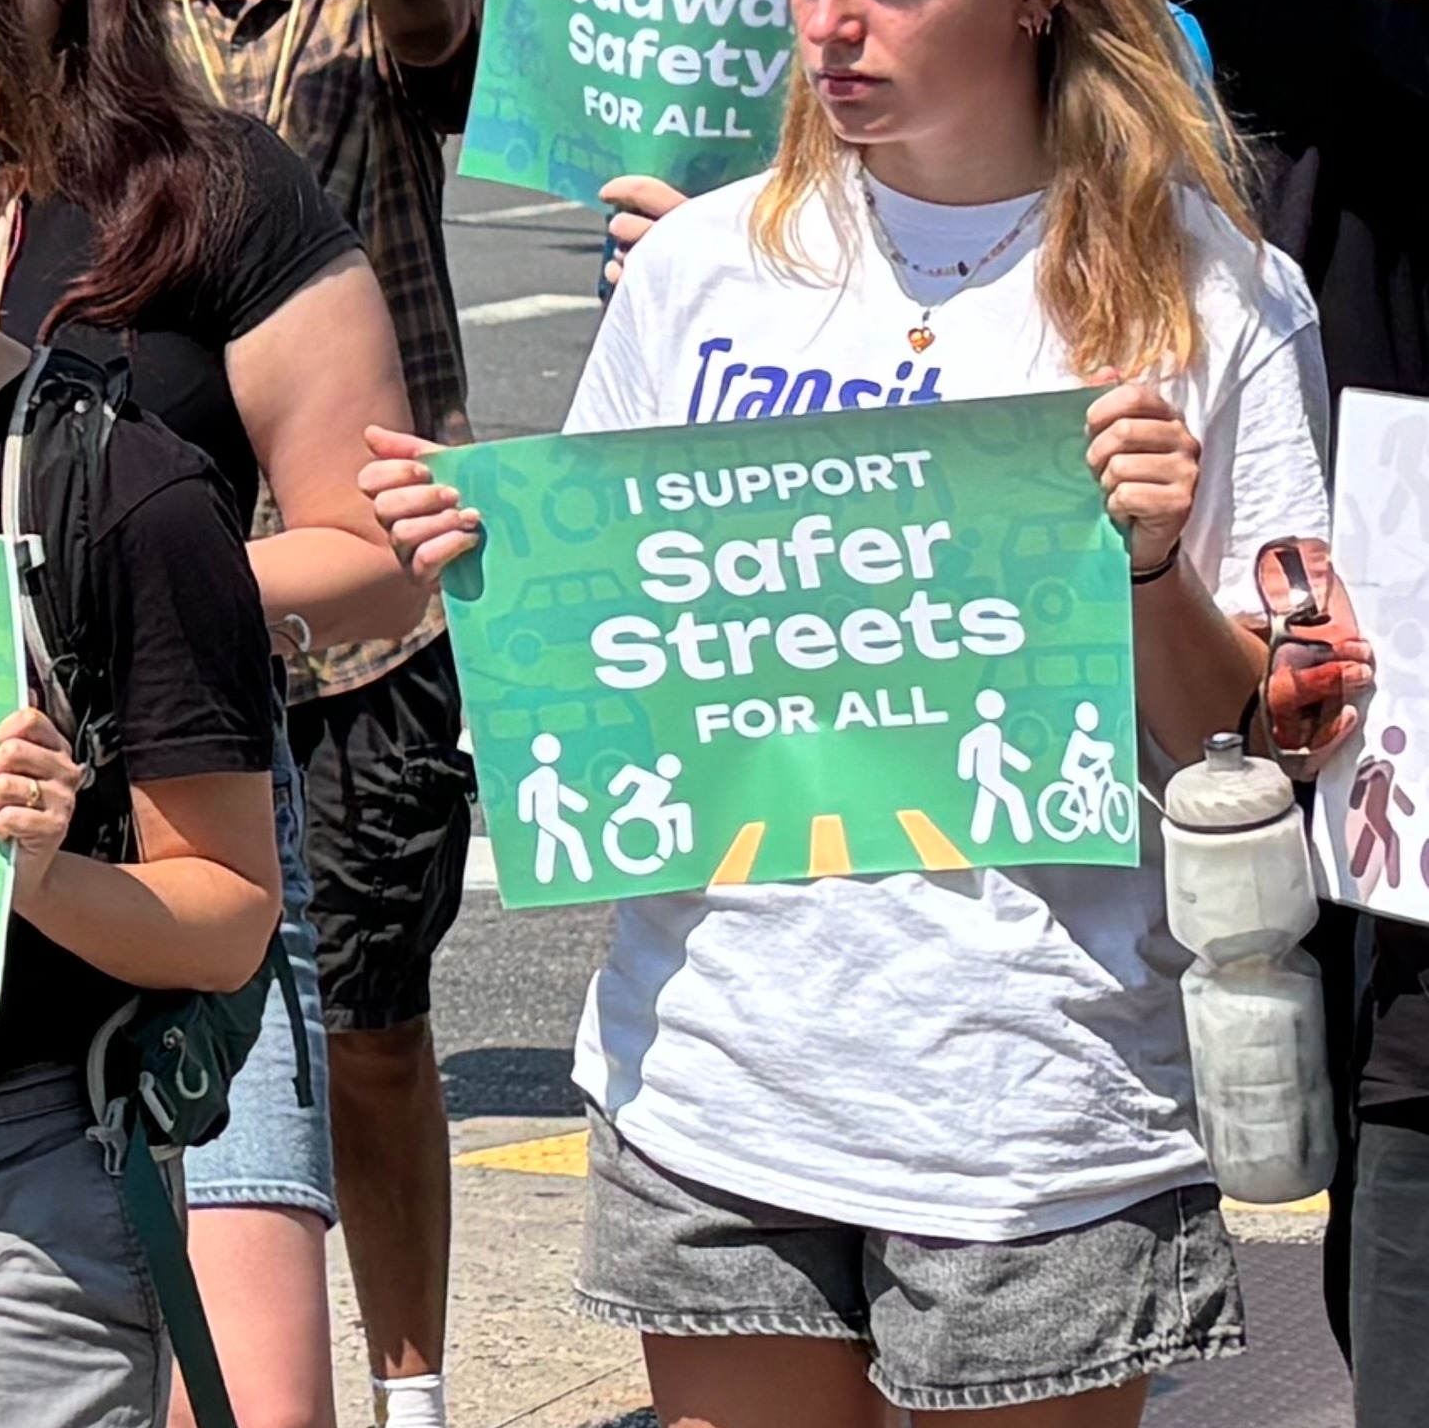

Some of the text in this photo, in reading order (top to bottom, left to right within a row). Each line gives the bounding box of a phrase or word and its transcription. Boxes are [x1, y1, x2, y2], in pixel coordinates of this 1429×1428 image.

[568, 12, 791, 98] Safety
[582, 85, 752, 139] FOR ALL
[624, 449, 933, 516] I SUPPORT
[635, 514, 954, 606] Safer
[590, 589, 1026, 691] Streets
[693, 686, 950, 745] FOR ALL
